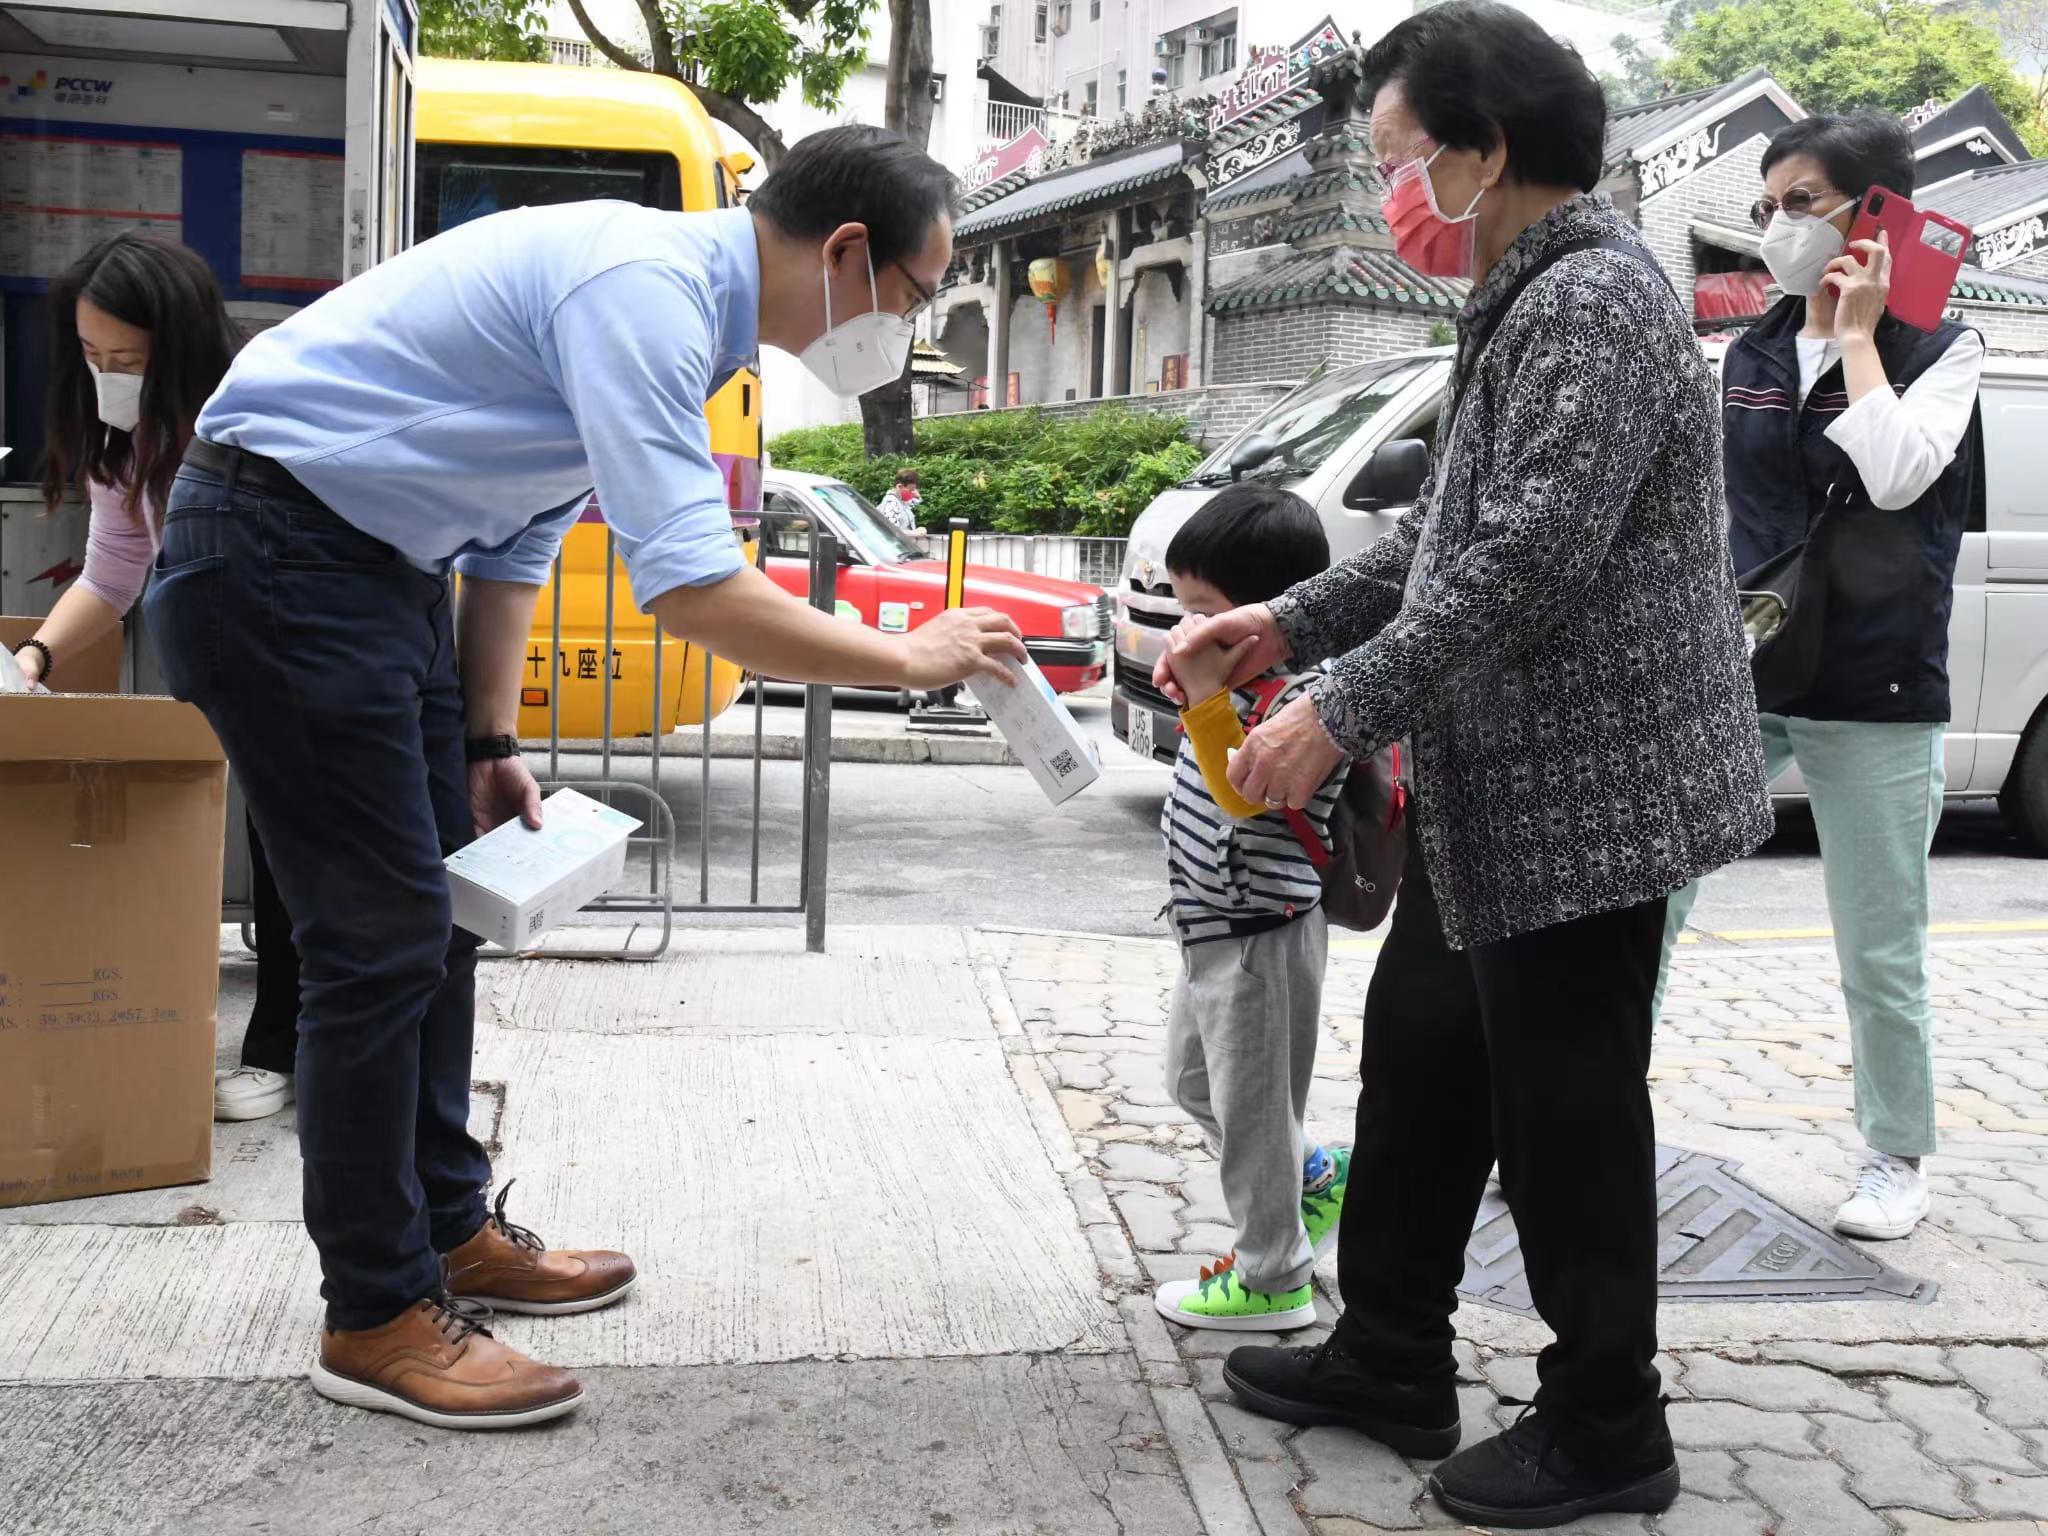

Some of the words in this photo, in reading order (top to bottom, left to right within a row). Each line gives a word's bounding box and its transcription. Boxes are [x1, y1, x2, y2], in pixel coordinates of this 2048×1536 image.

[55, 77, 112, 93] PCCW
[1135, 708, 1146, 732] US
[1132, 729, 1150, 757] 2109
